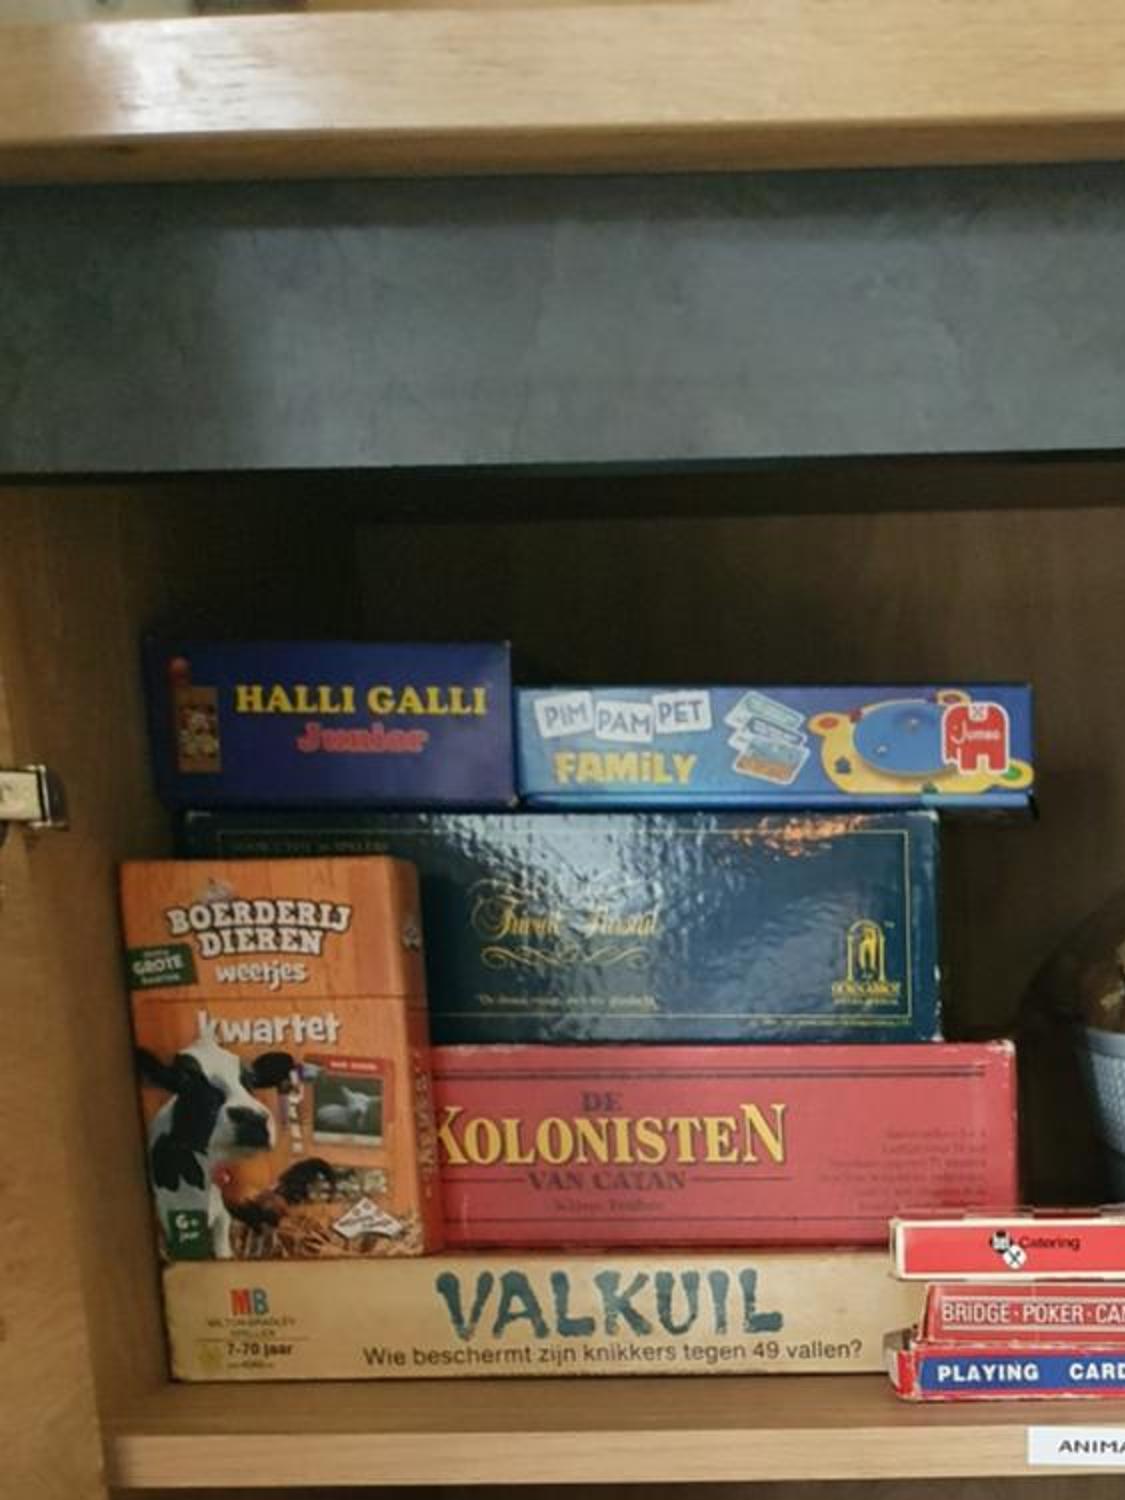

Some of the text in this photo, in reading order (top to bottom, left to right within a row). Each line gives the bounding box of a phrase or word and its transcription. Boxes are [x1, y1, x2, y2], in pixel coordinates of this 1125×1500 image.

[236, 684, 487, 715] HALLI GALLI
[544, 700, 704, 735] PIM PAM PET
[296, 721, 430, 753] Junior
[167, 899, 352, 937] BOERDERIJ
[197, 927, 325, 958] DIEREN
[132, 953, 184, 976] GROTE
[215, 959, 309, 991] weetjes
[580, 1090, 625, 1113] DE
[436, 1102, 787, 1167] KOLONISTEN
[527, 1170, 687, 1191] VAN CATAN
[229, 1287, 270, 1316] MB
[435, 1268, 785, 1341] VALKUIL
[942, 1302, 1011, 1323] BRIDGE
[1021, 1303, 1085, 1324] POKER
[362, 1346, 408, 1367] Wie
[412, 1344, 533, 1366] beschermt
[537, 1343, 578, 1367] zijn
[583, 1343, 678, 1364] knikkers
[683, 1342, 747, 1365] tegen
[752, 1341, 780, 1359] 49
[937, 1364, 1040, 1383] PLAYING
